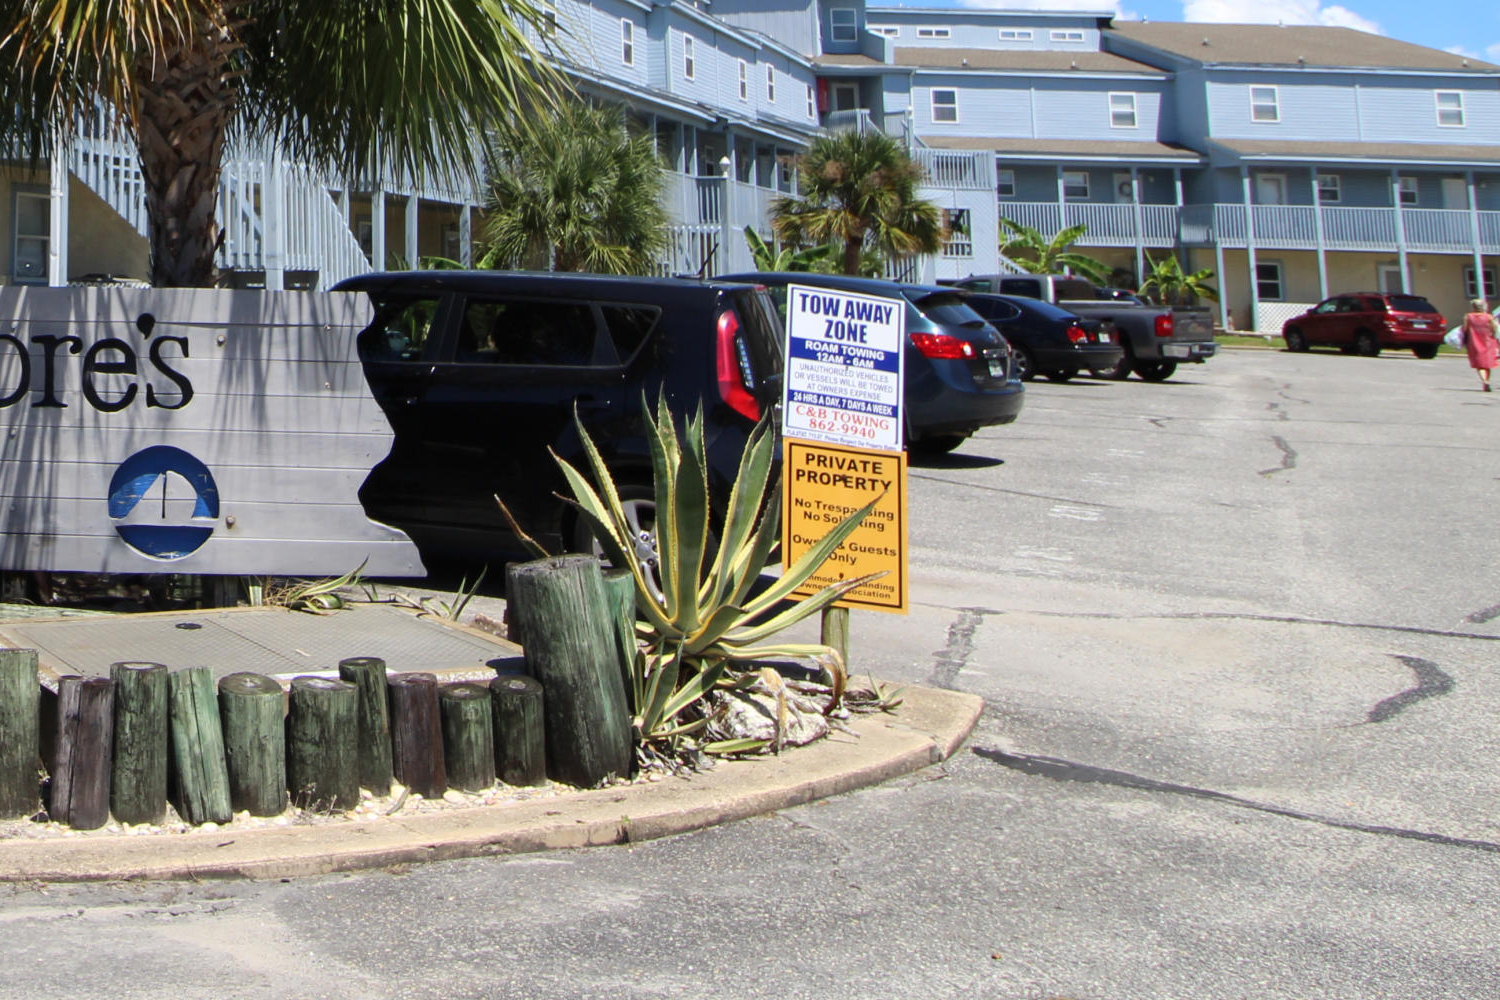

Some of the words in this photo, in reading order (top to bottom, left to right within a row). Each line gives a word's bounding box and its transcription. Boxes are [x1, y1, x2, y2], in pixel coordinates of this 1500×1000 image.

[799, 293, 841, 318] TOW
[844, 300, 893, 325] AWAY
[824, 319, 868, 344] ZONE
[805, 340, 839, 354] ROAM
[842, 345, 885, 361] TOWING
[816, 352, 844, 365] 12AM
[852, 358, 875, 369] 6AM
[794, 372, 805, 380] OR
[806, 373, 838, 385] VESSELS
[840, 378, 856, 388] WILL
[858, 381, 867, 389] BE
[868, 382, 893, 393] TOWED
[799, 363, 854, 378] UNAUTHORIZED
[856, 371, 889, 384] VEHICLES
[817, 384, 848, 396] OWNERS
[850, 389, 882, 401] EXPENSE
[793, 391, 802, 401] 24
[802, 393, 818, 403] HRS
[819, 395, 825, 404] A
[842, 398, 847, 408] 7
[847, 400, 867, 411] DAYS
[867, 403, 873, 412] A
[873, 404, 892, 416] WEEK
[795, 404, 827, 419] C&B
[832, 410, 889, 431] TOWING
[809, 418, 876, 440] 862-9940
[805, 453, 883, 475] PRIVATE
[796, 469, 892, 492] PROPERTY
[795, 498, 811, 508] No
[815, 500, 894, 521] Trespasing
[803, 511, 820, 521] No
[823, 513, 885, 532] Solting
[829, 551, 857, 566] Only
[849, 542, 897, 556] Guests
[858, 581, 895, 593] anding
